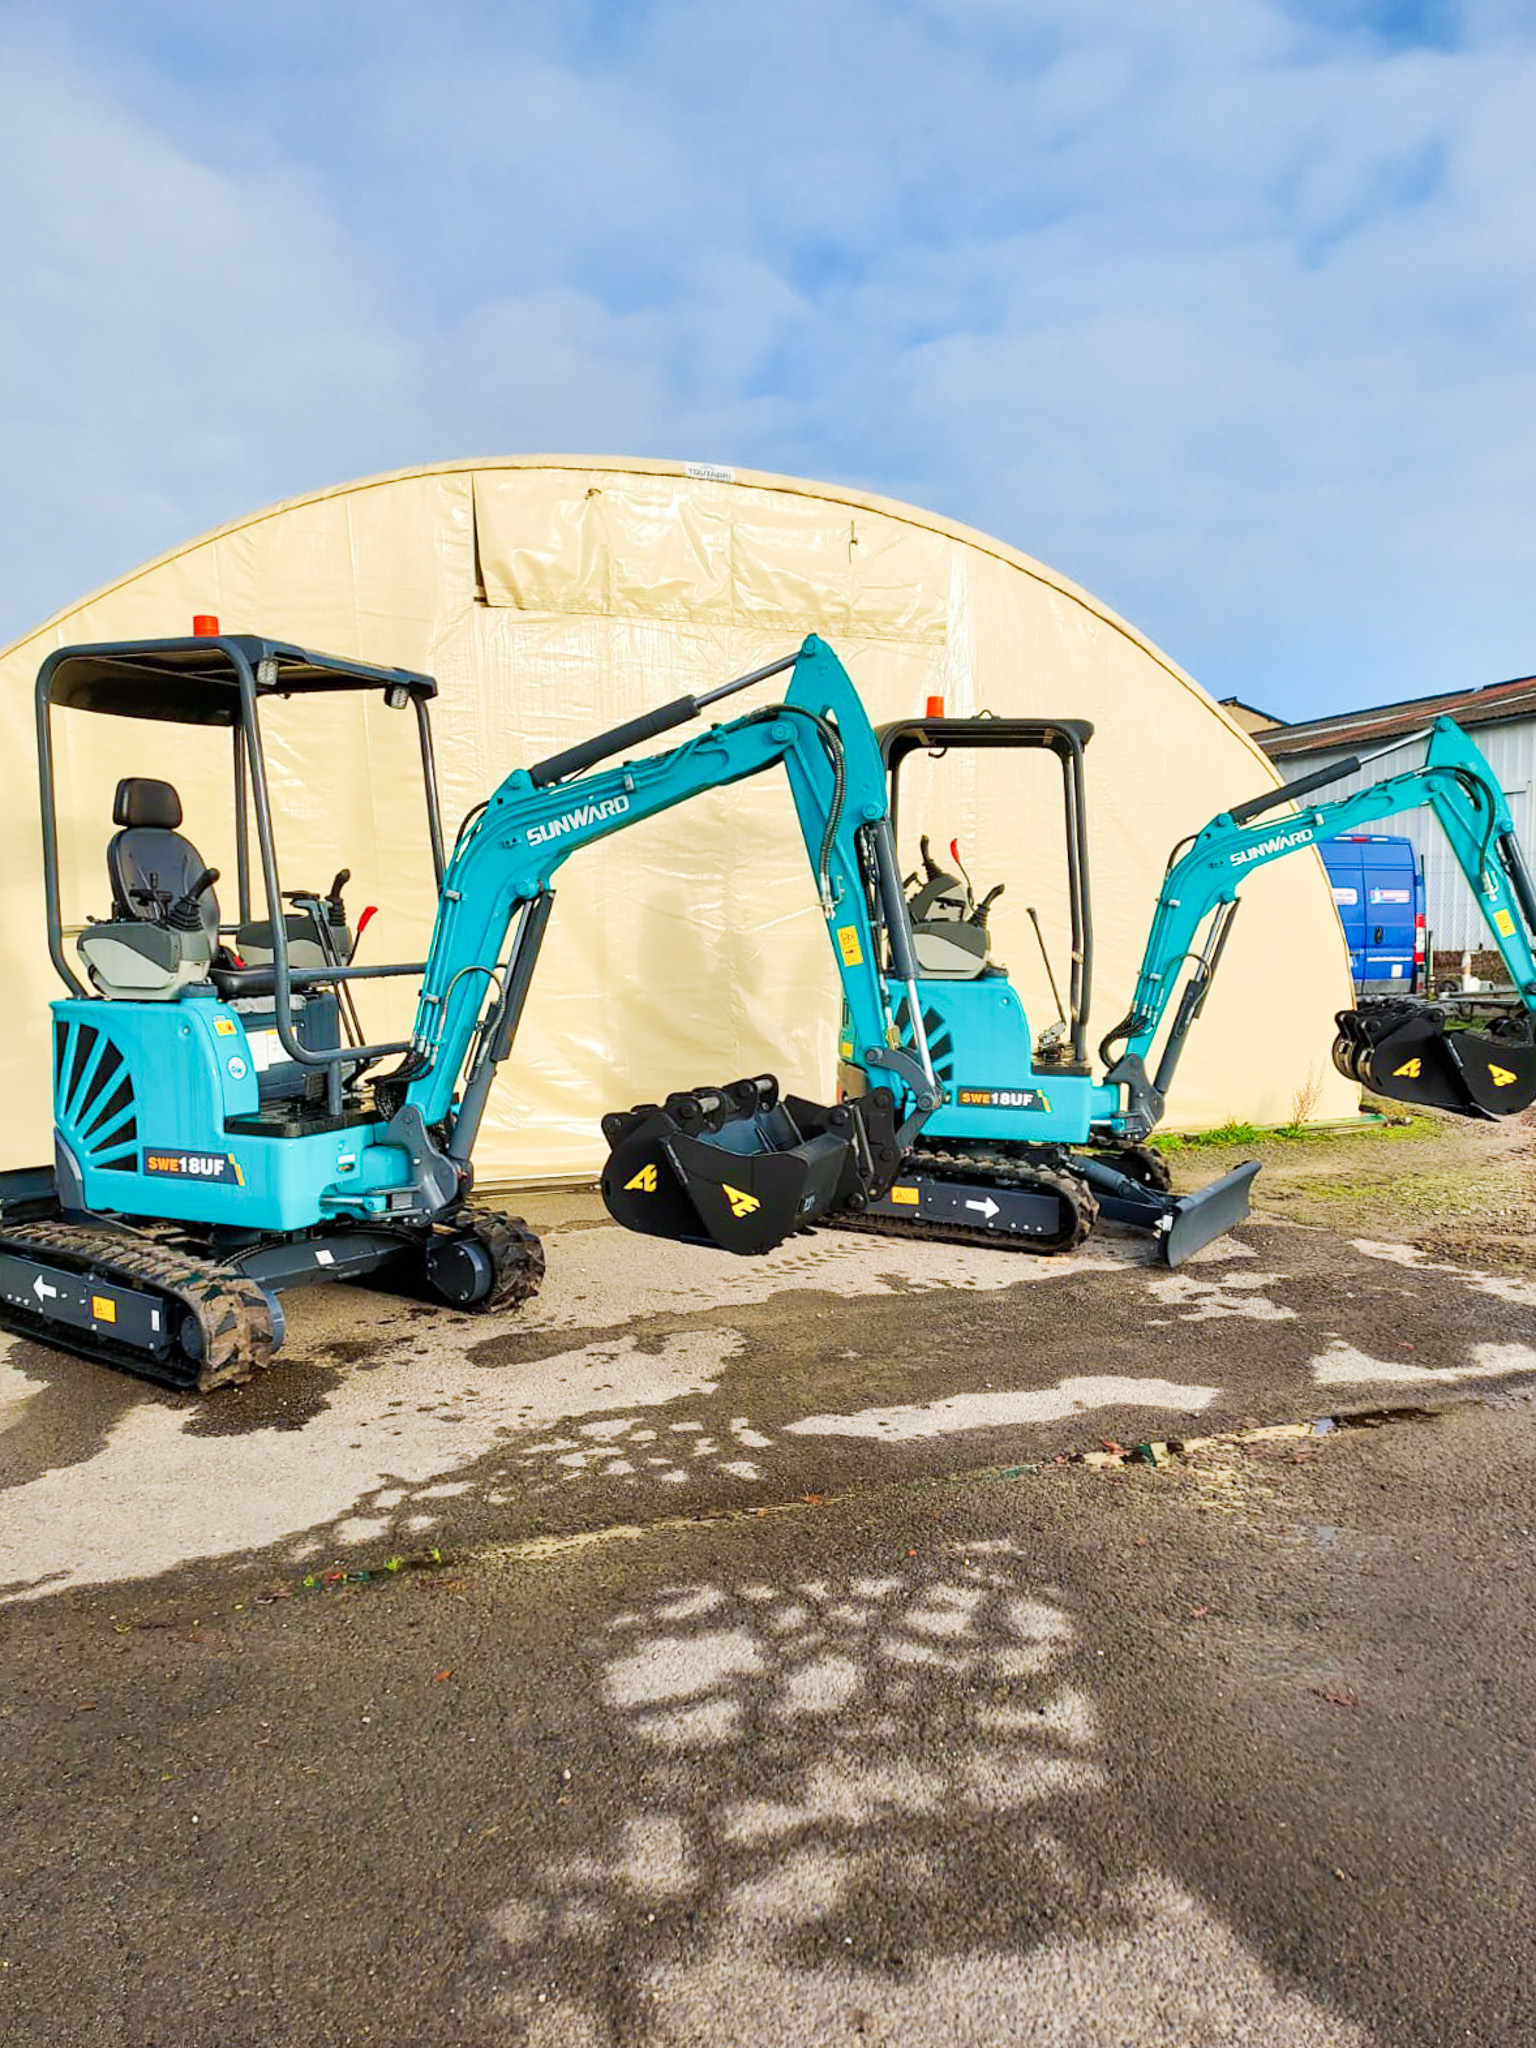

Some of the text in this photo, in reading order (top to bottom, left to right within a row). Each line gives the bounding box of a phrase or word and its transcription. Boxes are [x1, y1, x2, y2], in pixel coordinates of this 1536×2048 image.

[526, 794, 630, 847] SUNWARD
[1229, 828, 1313, 867] SUNWARD
[960, 1092, 1033, 1106] SWE18UF
[147, 1155, 225, 1176] SWE18UF
